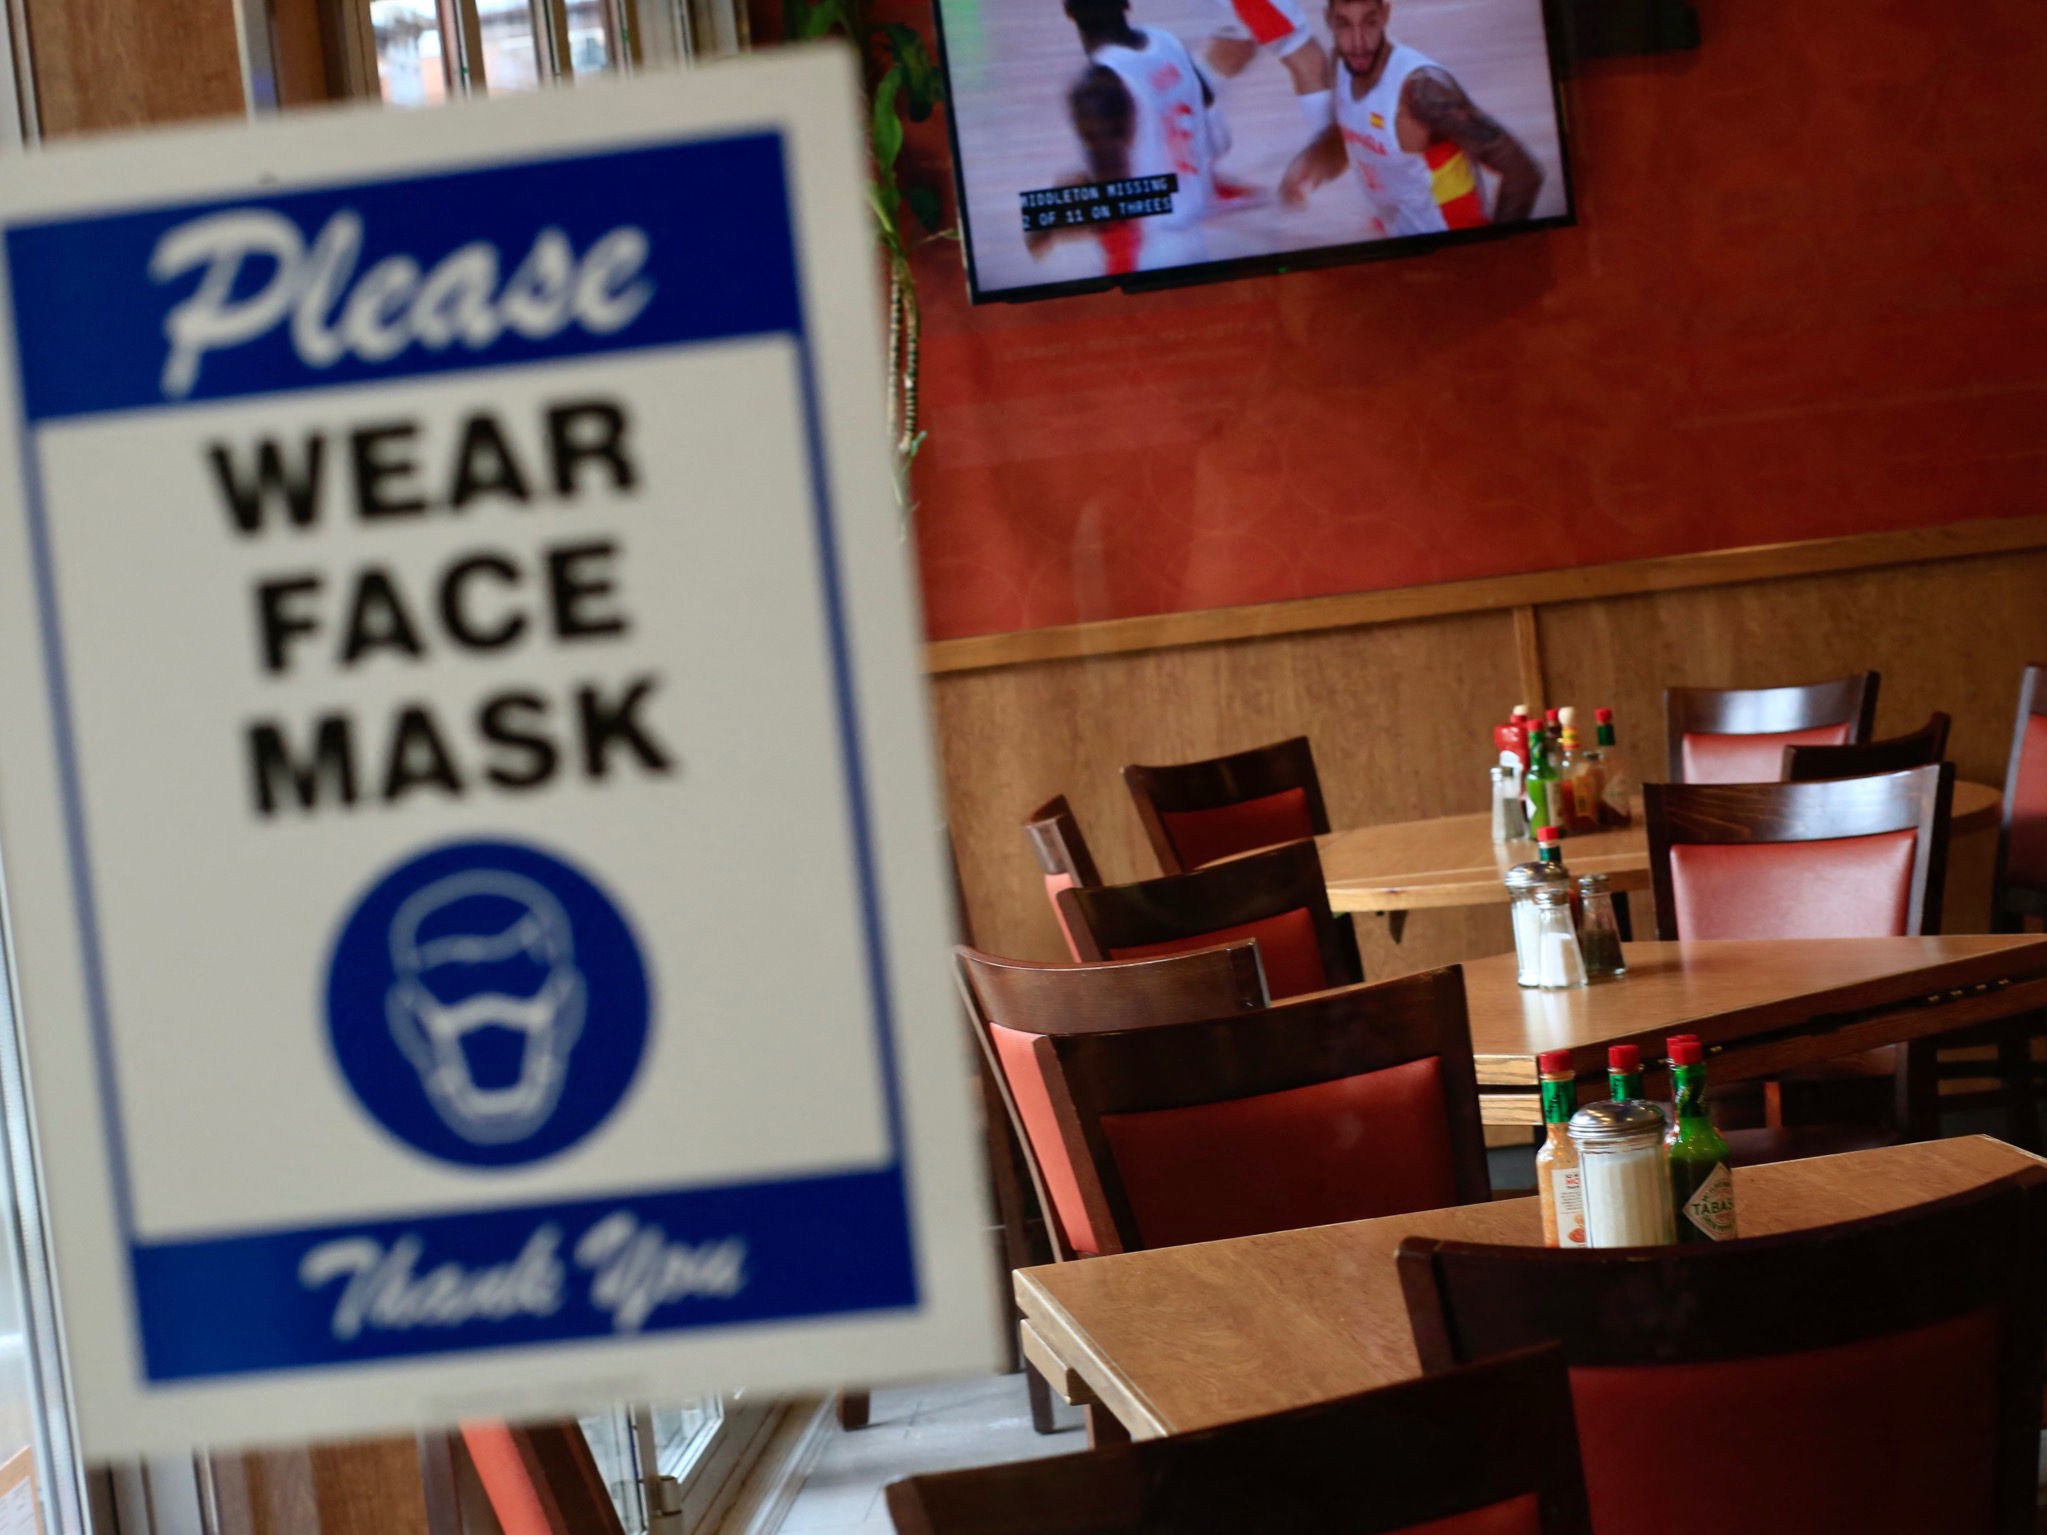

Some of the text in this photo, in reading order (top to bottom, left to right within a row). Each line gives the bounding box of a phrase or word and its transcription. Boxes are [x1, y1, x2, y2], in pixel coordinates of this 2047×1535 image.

[1020, 177, 1169, 208] MIDDLETON MISSING
[1038, 211, 1056, 226] OF
[1065, 209, 1084, 223] 11
[1091, 205, 1111, 219] ON
[1119, 198, 1172, 216] THREES
[148, 206, 656, 398] Please
[205, 398, 642, 542] WEAR
[252, 536, 632, 682] FACE
[245, 672, 680, 822] MASK
[298, 1210, 748, 1340] Thank You
